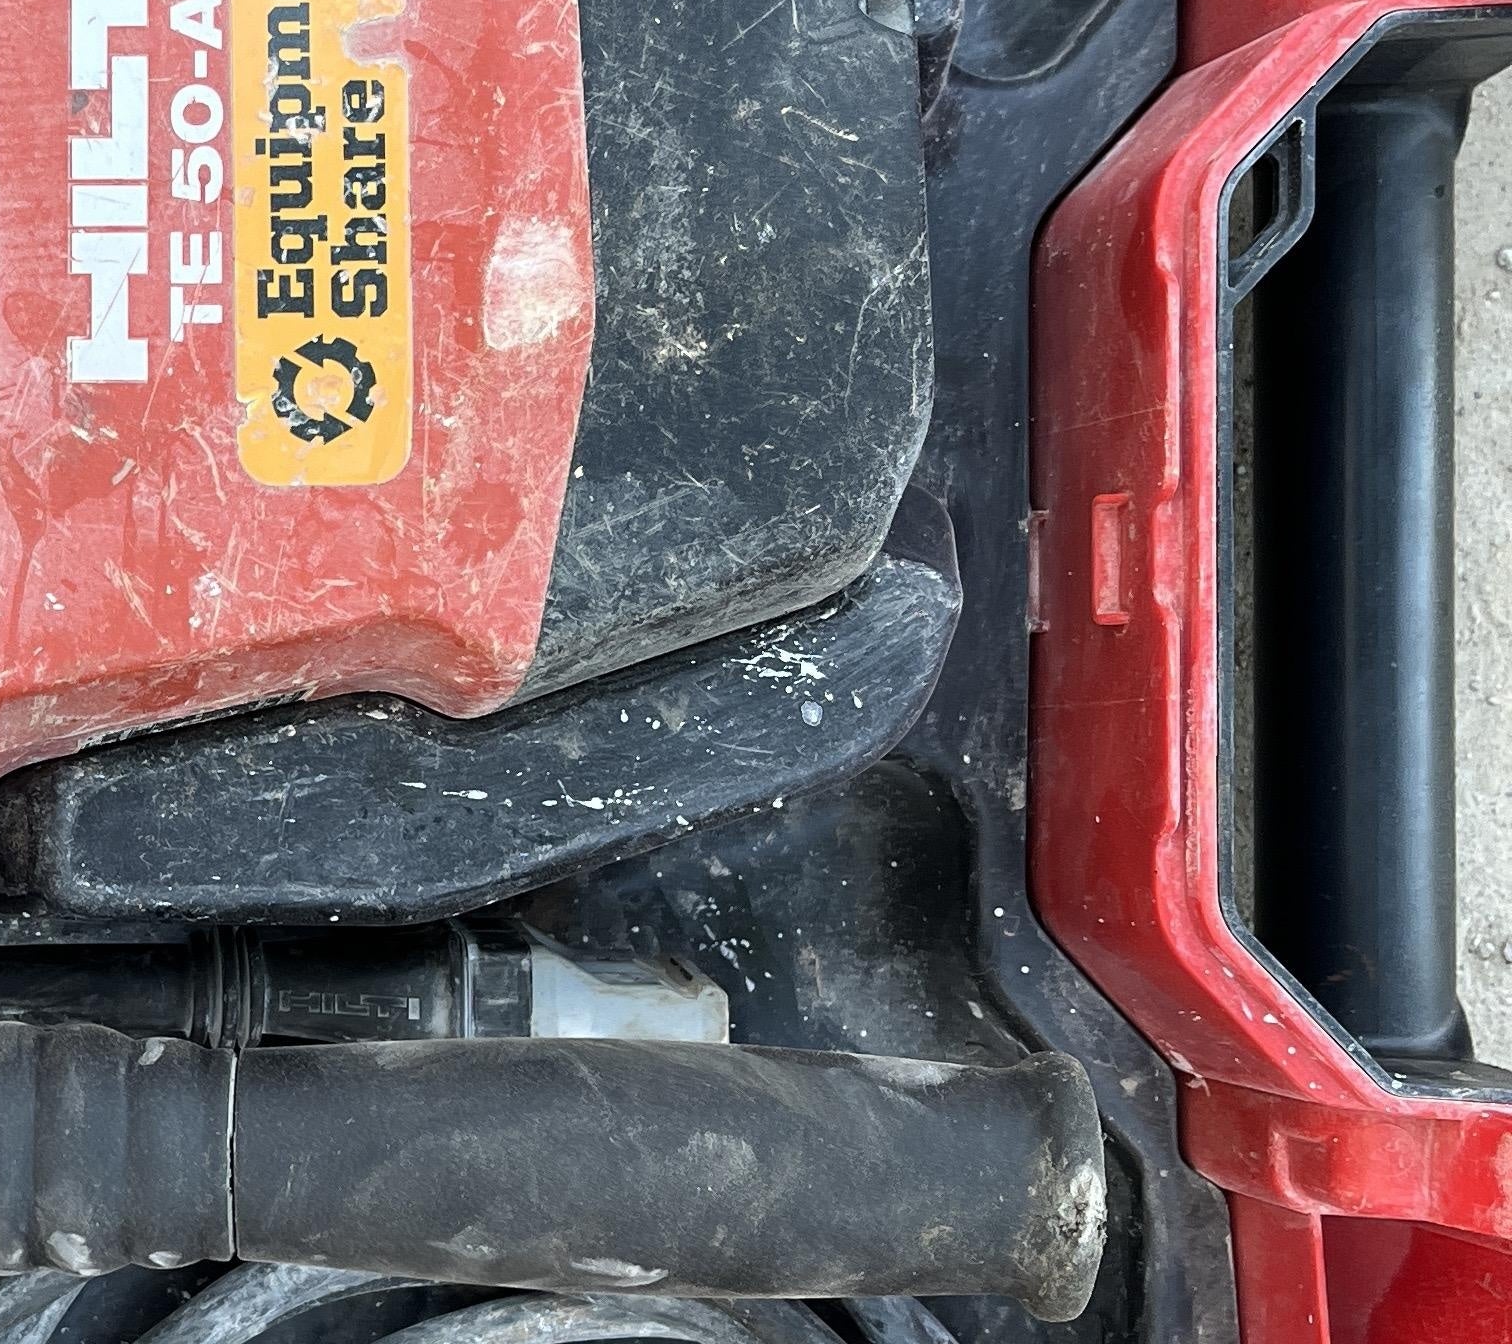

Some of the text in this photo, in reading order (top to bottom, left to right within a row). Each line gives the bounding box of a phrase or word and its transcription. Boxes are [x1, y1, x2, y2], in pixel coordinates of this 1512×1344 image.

[330, 77, 389, 319] Share
[169, 230, 224, 343] TE
[278, 989, 421, 1021] HILTI
